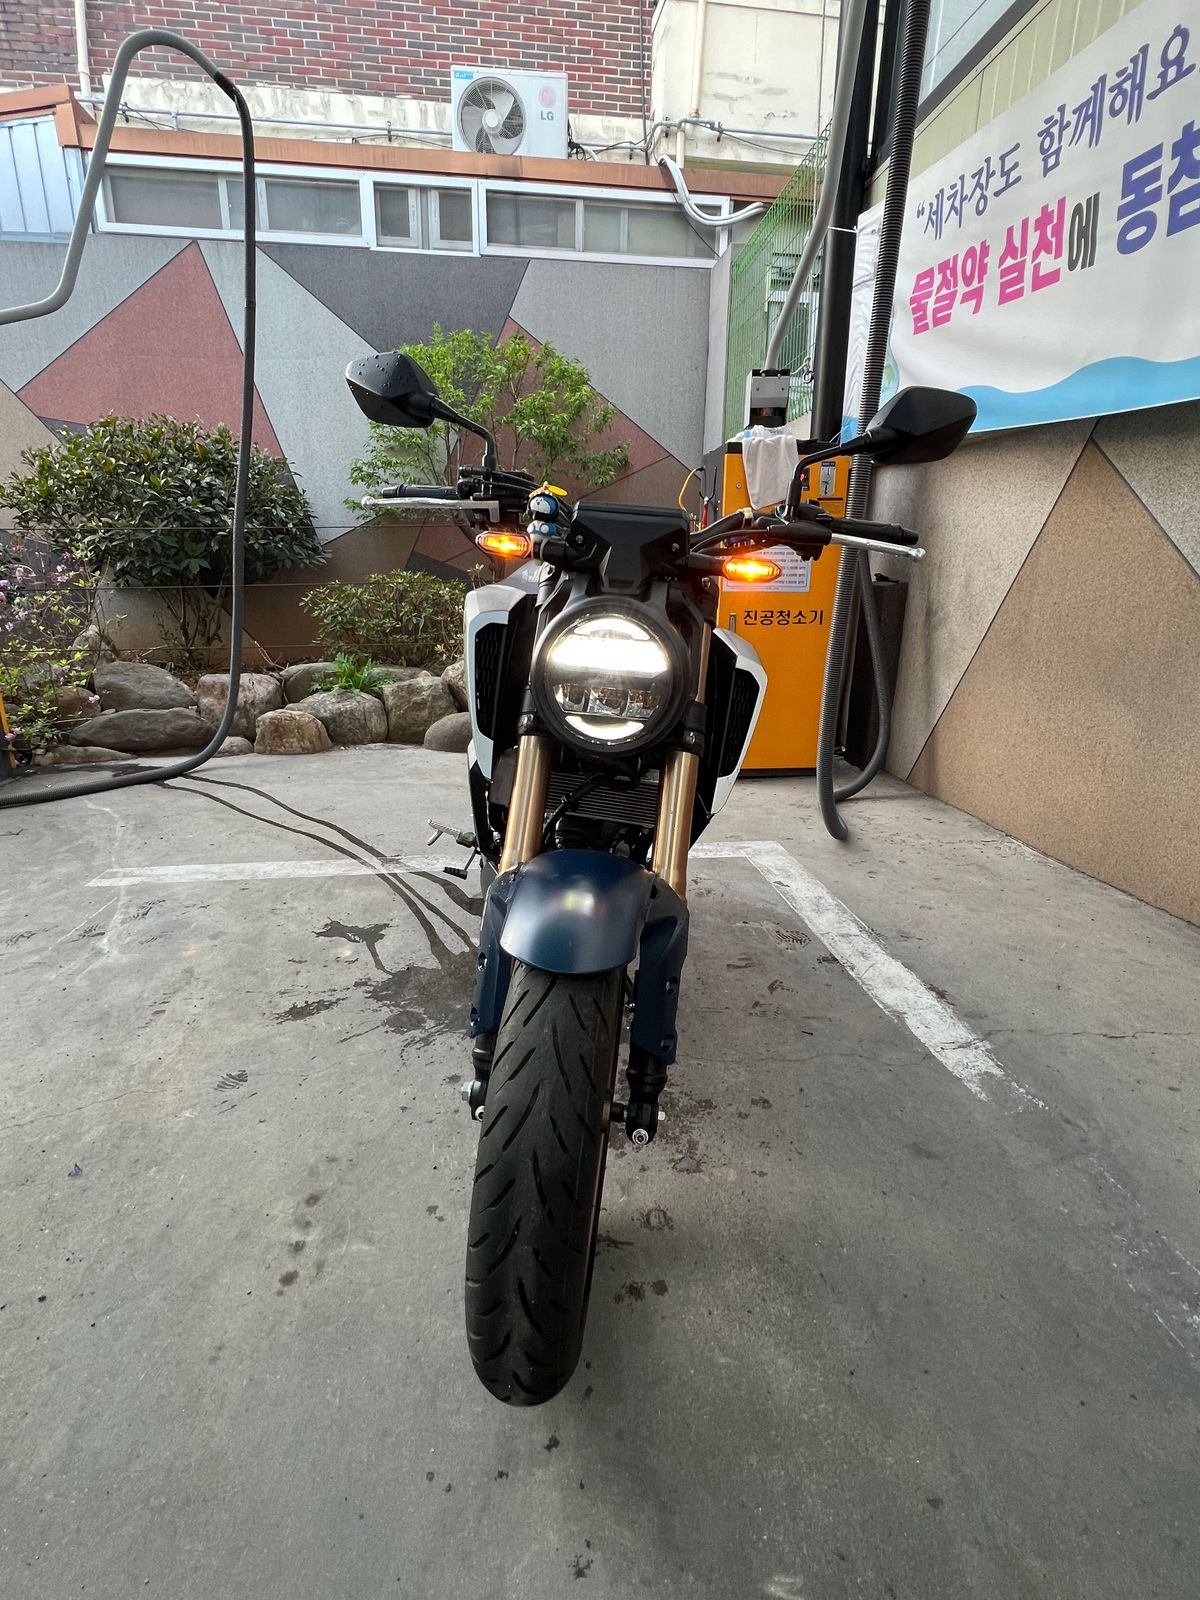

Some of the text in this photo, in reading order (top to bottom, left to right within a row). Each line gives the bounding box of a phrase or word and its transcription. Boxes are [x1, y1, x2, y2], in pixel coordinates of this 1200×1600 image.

[540, 111, 554, 121] LG
[909, 240, 990, 336] 물절약
[997, 192, 1100, 306] 실천에
[743, 610, 824, 626] 진공청소기
